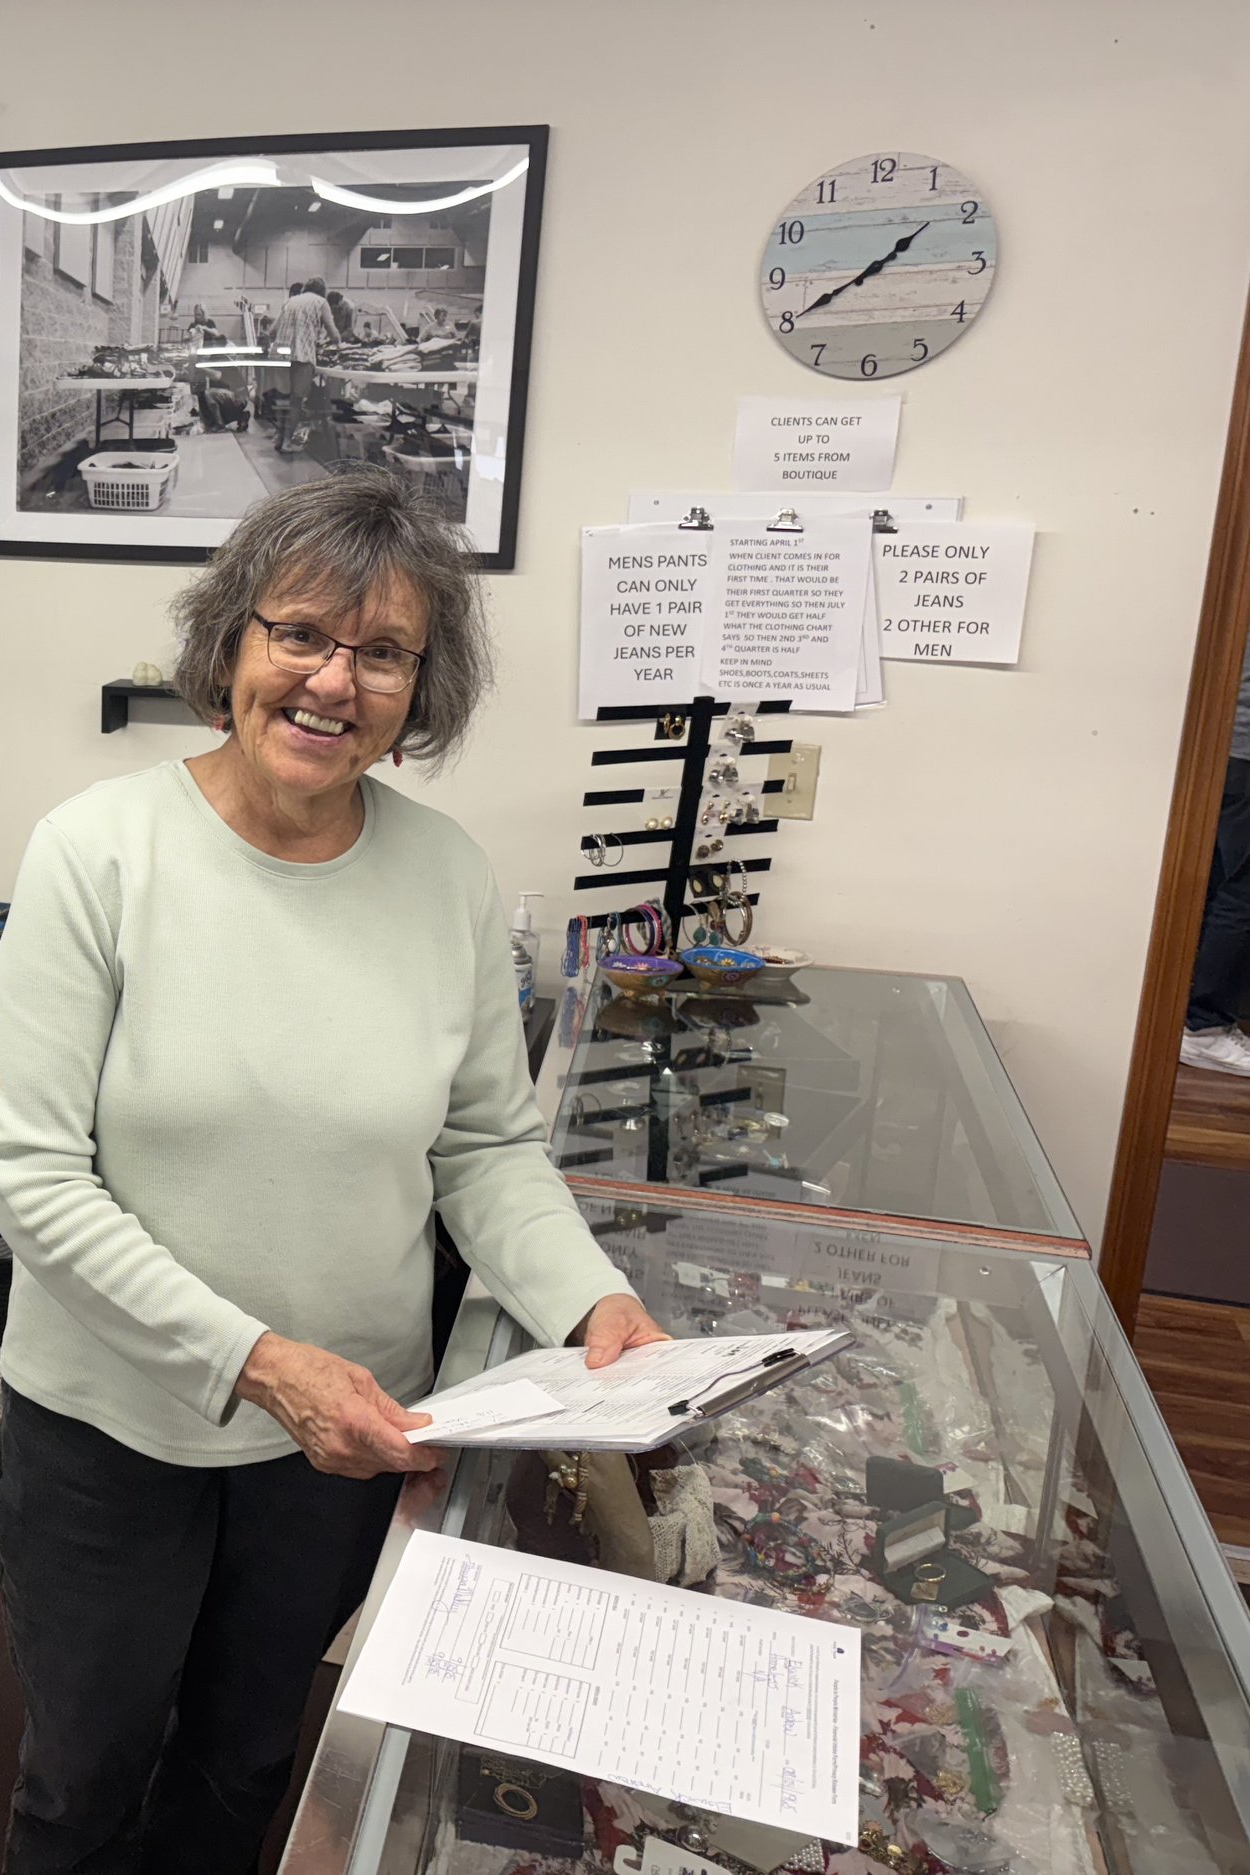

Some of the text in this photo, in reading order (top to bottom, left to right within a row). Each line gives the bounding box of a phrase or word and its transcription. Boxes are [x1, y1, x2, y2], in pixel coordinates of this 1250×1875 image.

[871, 159, 896, 183] 12
[929, 167, 938, 191] 1
[817, 180, 836, 204] 11
[961, 201, 978, 224] 2
[779, 221, 804, 244] 10
[968, 251, 986, 274] 3
[769, 268, 785, 290] 9
[950, 300, 967, 322] 4
[779, 312, 794, 333] 8
[810, 344, 826, 366] 7
[911, 338, 928, 361] 5
[861, 354, 877, 376] 6
[771, 417, 862, 426] CLIENTS CAN GET
[799, 435, 829, 444] UP TO
[774, 453, 850, 461] 5 ITEMS FROM
[783, 471, 837, 480] BOUTIQUE
[883, 545, 989, 558] PLEASE ONLY
[609, 554, 707, 569] MENS PANTS
[899, 571, 987, 584] 2 PAIRS OF
[617, 579, 697, 593] CAN ONLY
[611, 601, 702, 615] HAVE 1 PAIR
[742, 600, 789, 608] EVERYTHING
[914, 595, 963, 608] JEANS
[624, 624, 687, 637] OF NEW
[884, 619, 989, 634] 2 OTHER FOR
[614, 646, 694, 659] JEANS PER
[914, 644, 952, 656] MEN
[634, 668, 672, 680] YEAR
